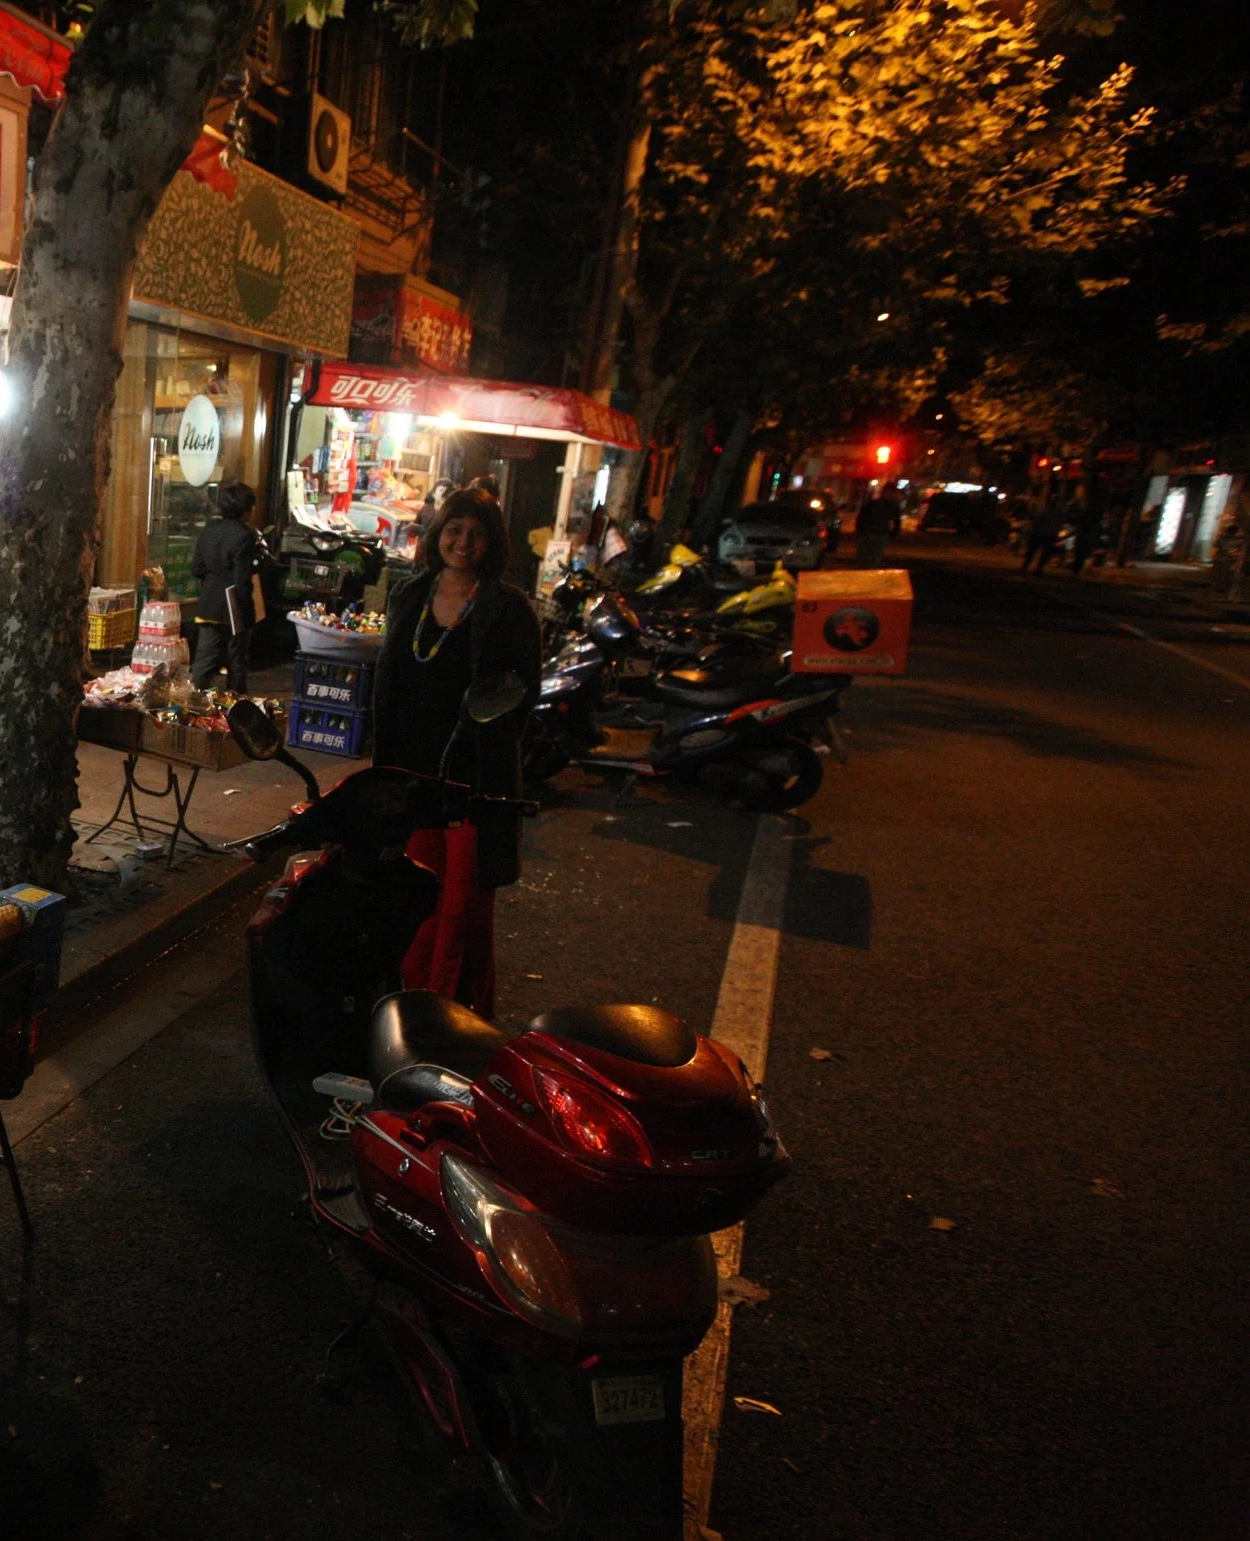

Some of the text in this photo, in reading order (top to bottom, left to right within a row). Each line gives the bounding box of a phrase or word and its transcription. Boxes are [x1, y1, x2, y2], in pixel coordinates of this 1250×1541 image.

[330, 375, 423, 406] 可口可乐
[306, 683, 351, 702] 百事可乐
[301, 729, 346, 749] 百事可乐
